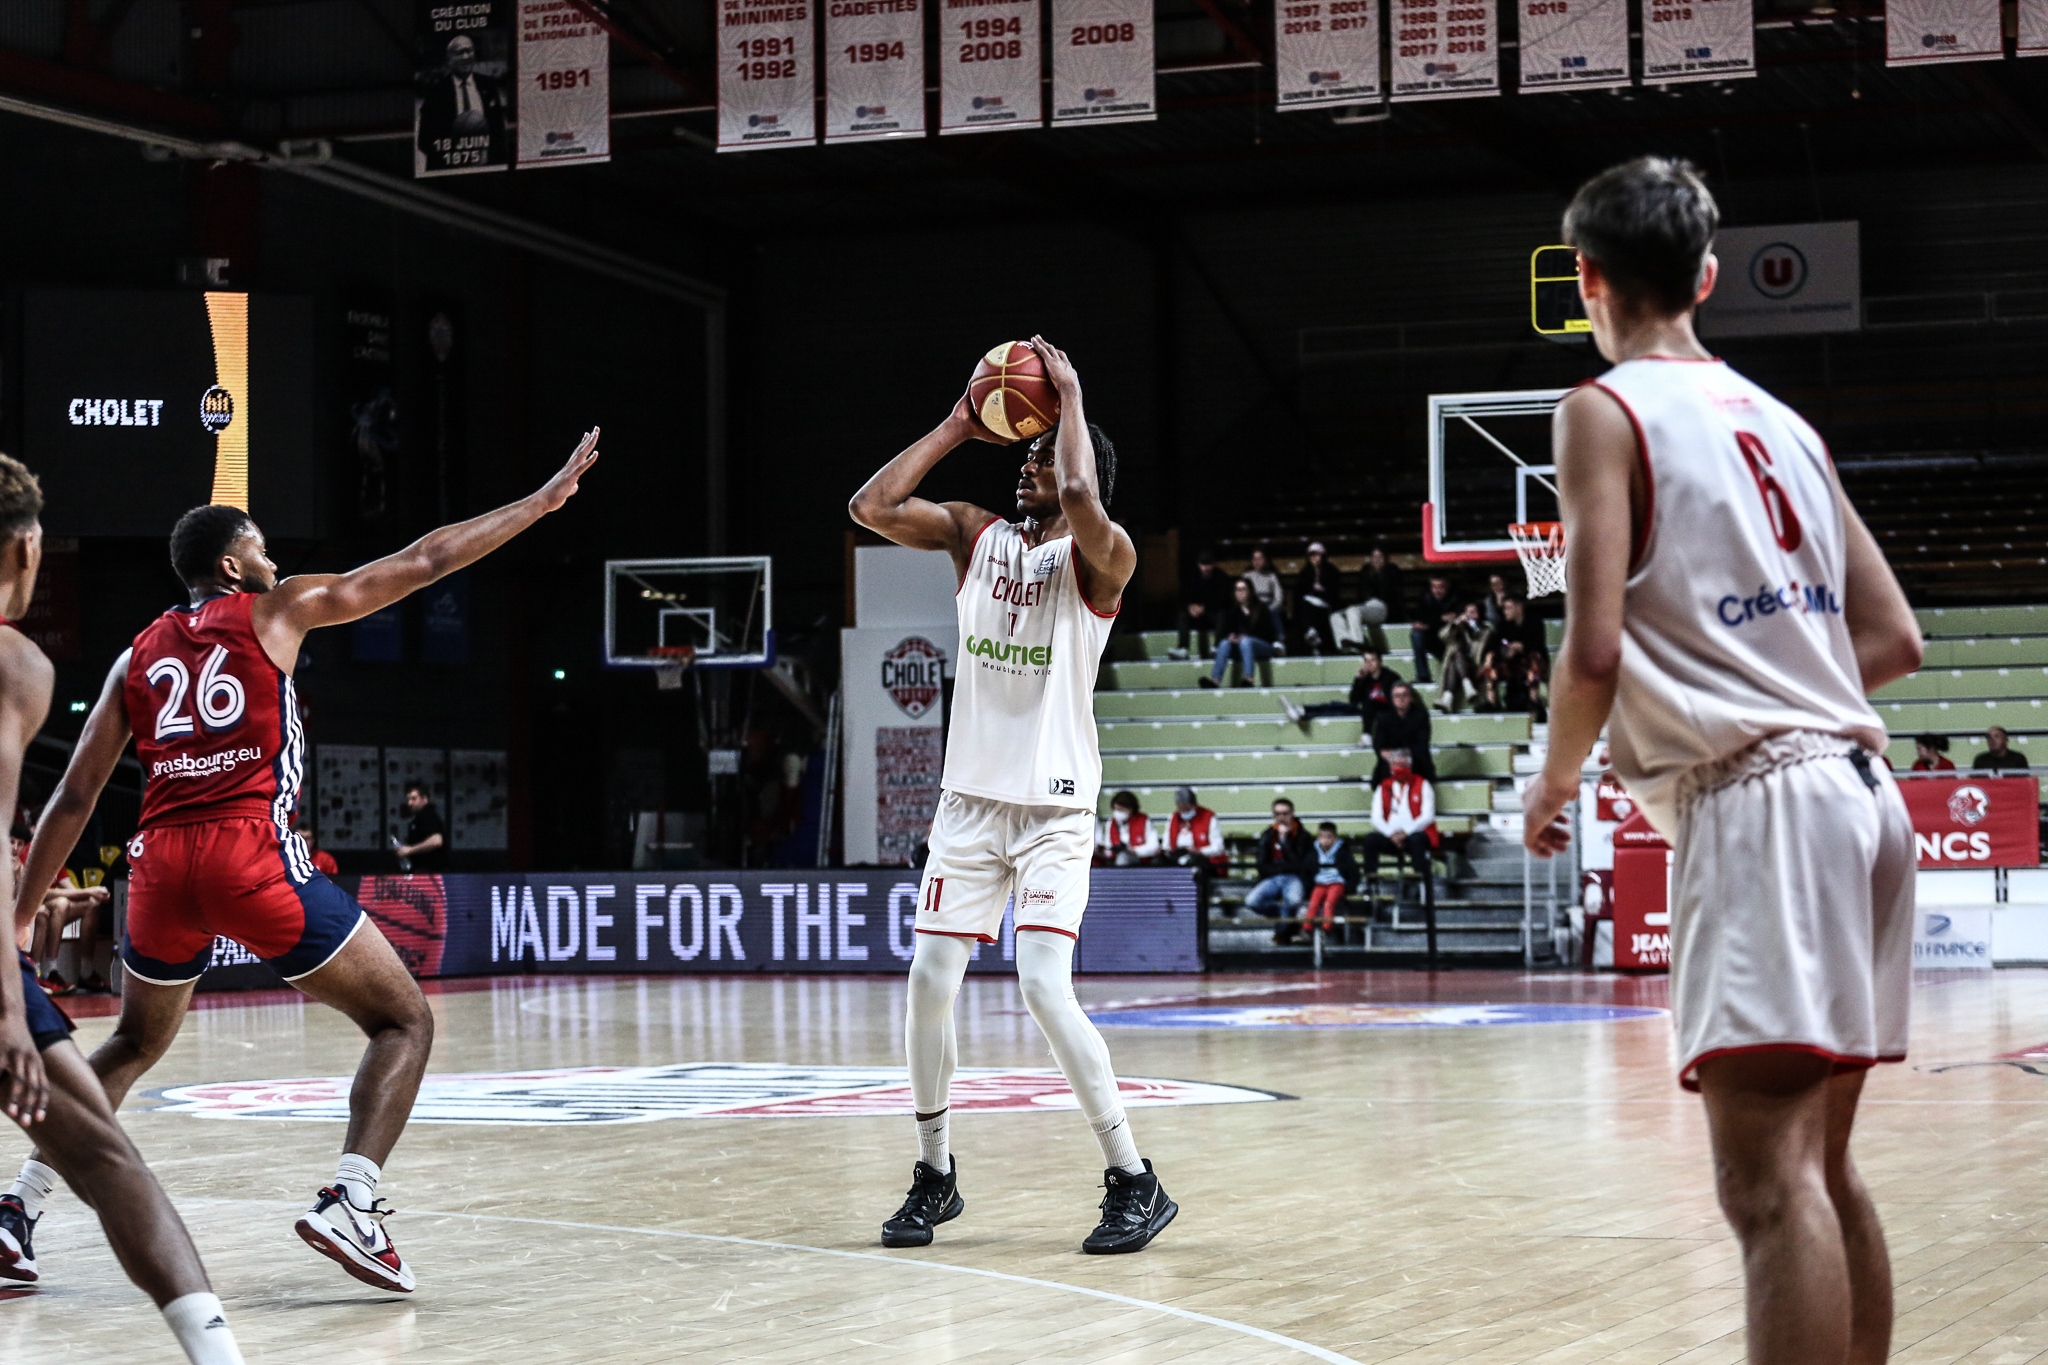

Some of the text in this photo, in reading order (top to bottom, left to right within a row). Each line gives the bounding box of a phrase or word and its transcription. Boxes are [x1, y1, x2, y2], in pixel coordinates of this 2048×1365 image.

[431, 3, 491, 19] CRÉATION
[724, 0, 740, 10] DE
[830, 0, 918, 18] CADETTES
[1284, 1, 1368, 19] 1997 2001
[1528, 2, 1567, 16] 2019
[434, 16, 488, 31] DU CLUB
[524, 19, 538, 29] DE
[725, 7, 807, 26] MINIMES
[1400, 8, 1486, 25] 1998 2000
[1652, 8, 1692, 22] 2019
[523, 27, 588, 42] NATIONALE
[960, 17, 1022, 39] 1994
[1071, 23, 1135, 46] 2008
[1284, 16, 1368, 34] 2012 2017
[1399, 24, 1486, 41] 2001 2015
[736, 36, 795, 59] 1991
[844, 41, 905, 64] 1994
[959, 40, 1022, 63] 2008
[1399, 44, 1438, 57] 2017
[736, 59, 797, 81] 1992
[536, 69, 591, 91] 1991
[434, 135, 490, 151] 18 JUIN
[443, 150, 481, 165] 1975
[1763, 257, 1794, 287] U
[68, 398, 163, 426] CHOLET
[1735, 430, 1802, 553] 6
[992, 576, 1044, 607] CHOET
[881, 658, 948, 688] CHOLET
[146, 644, 245, 741] 26
[924, 877, 945, 912] 11
[491, 884, 617, 962] MADE
[636, 883, 746, 961] FOR
[760, 882, 869, 961] THE
